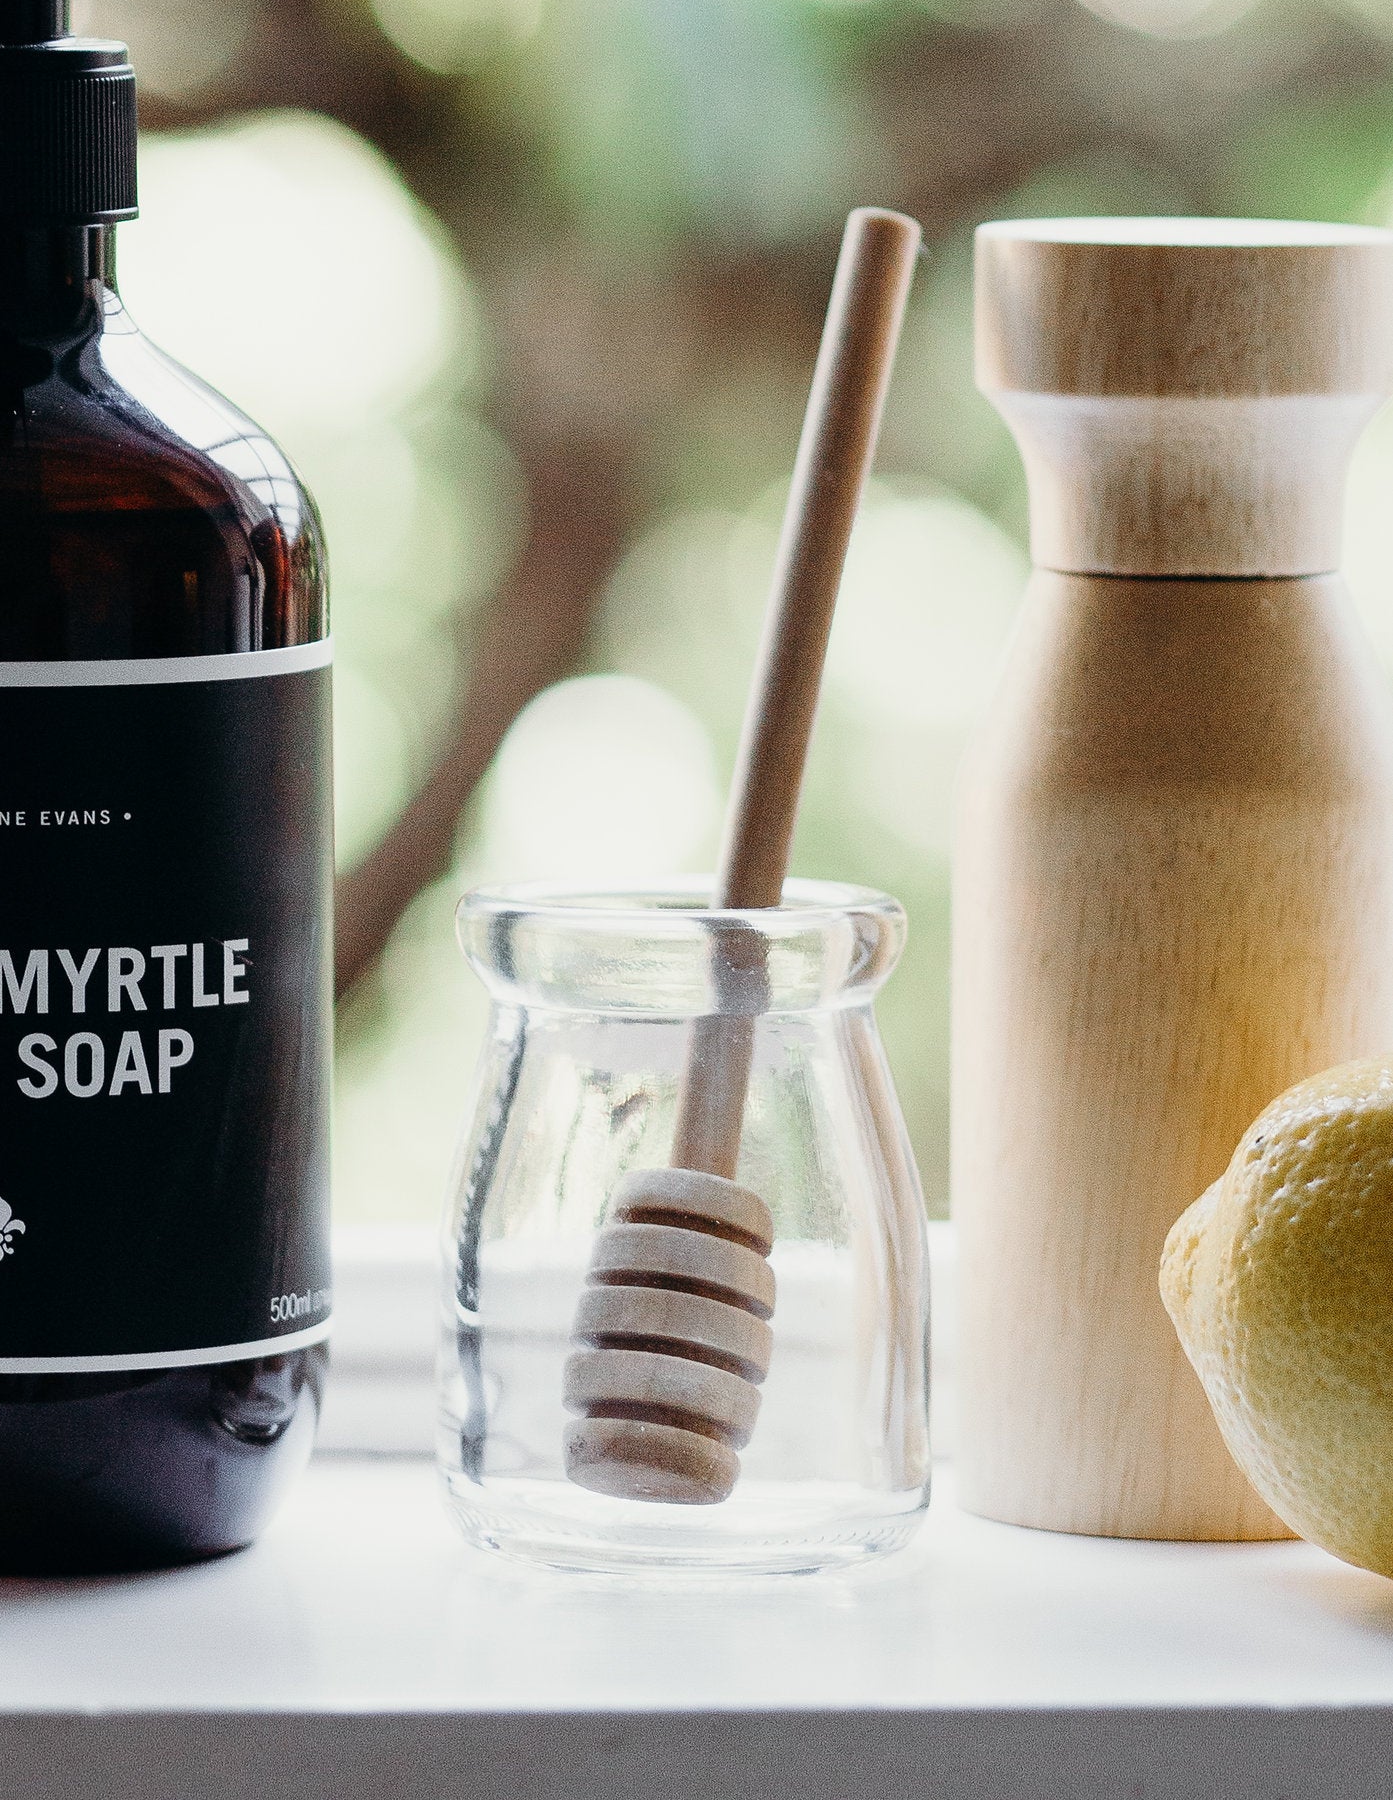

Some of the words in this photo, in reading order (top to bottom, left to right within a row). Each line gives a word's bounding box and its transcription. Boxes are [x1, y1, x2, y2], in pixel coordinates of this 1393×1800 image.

[40, 809, 111, 826] EVANS
[16, 1028, 195, 1099] SOAP
[270, 1289, 311, 1322] 500ml
